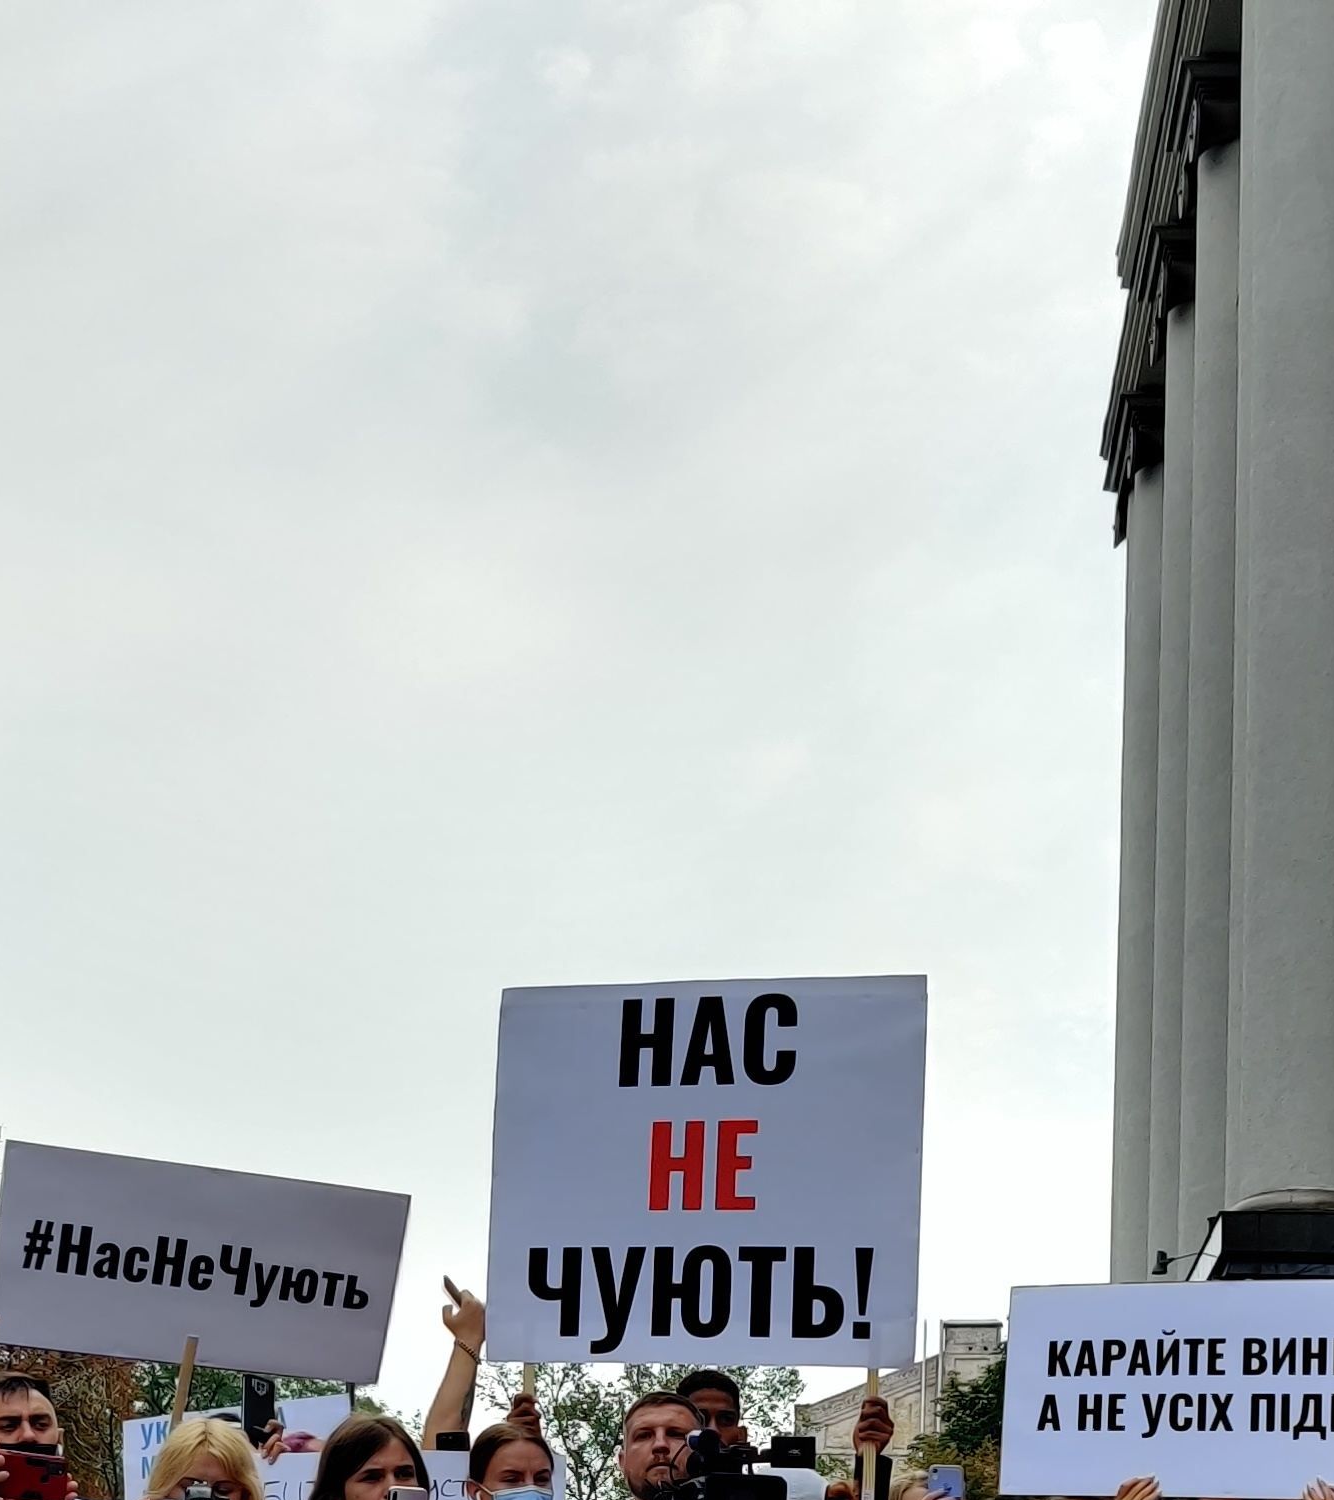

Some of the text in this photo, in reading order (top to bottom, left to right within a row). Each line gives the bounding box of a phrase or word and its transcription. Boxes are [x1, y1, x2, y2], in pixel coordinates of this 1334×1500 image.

[619, 993, 798, 1087] НАС
[648, 1120, 759, 1211] НЕ
[22, 1219, 369, 1310] #НасНеЧують
[528, 1245, 874, 1354] ЧУЮТЬ!
[1047, 1328, 1226, 1377] КАРАЙТЕ
[1036, 1393, 1061, 1432] А
[1077, 1393, 1127, 1432] НЕ
[1141, 1393, 1234, 1438] УСІХ
